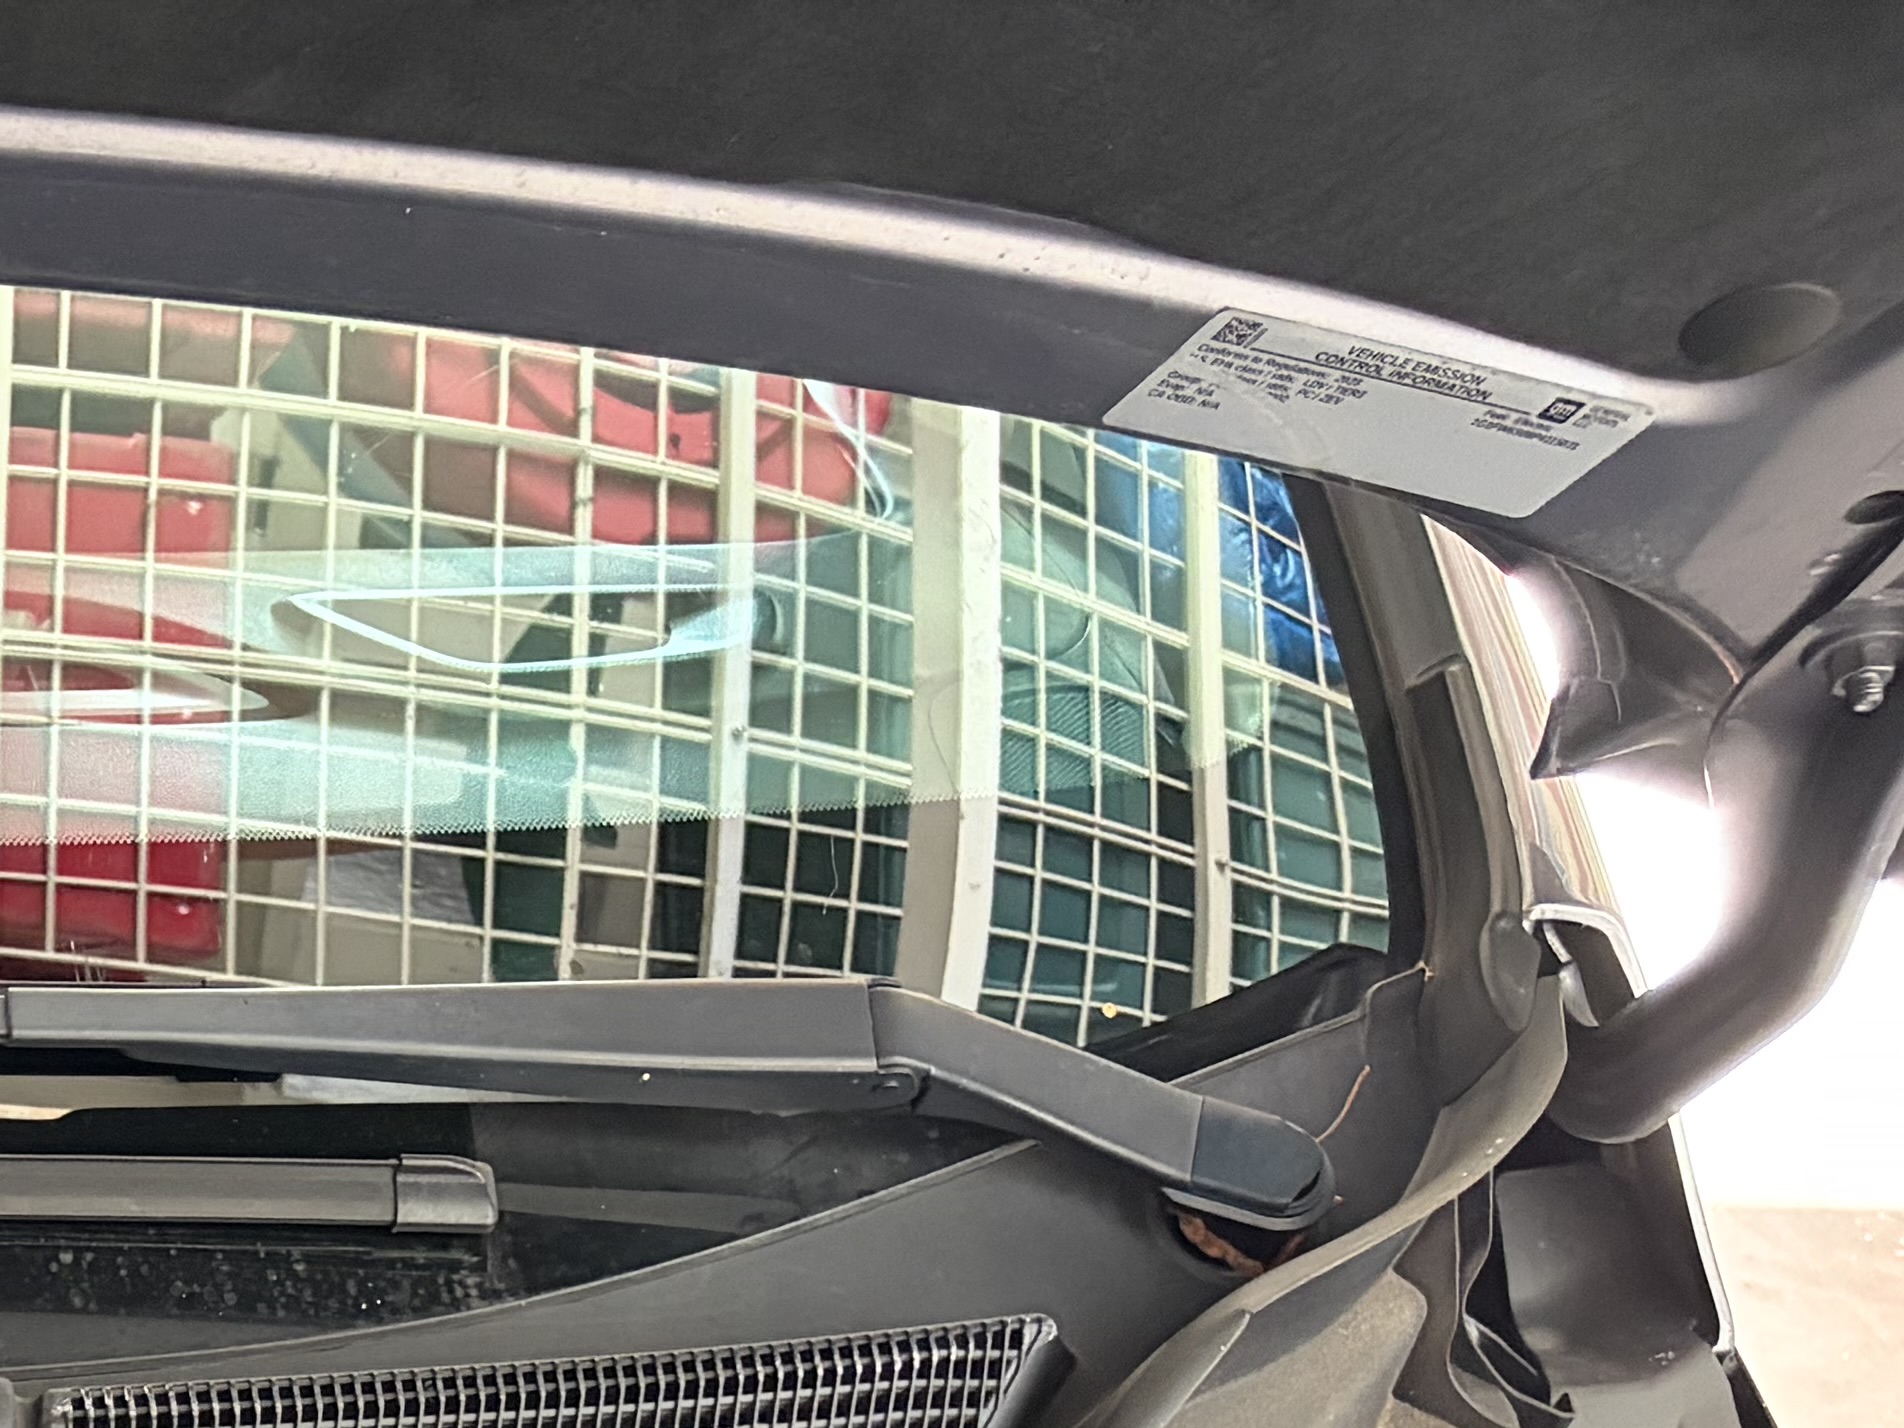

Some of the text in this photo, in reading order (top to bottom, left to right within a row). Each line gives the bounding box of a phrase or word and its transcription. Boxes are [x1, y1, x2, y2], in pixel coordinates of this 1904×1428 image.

[1315, 352, 1492, 401] CONTROL INFORMATION
[1348, 345, 1488, 387] VEHICLE EMISSION
